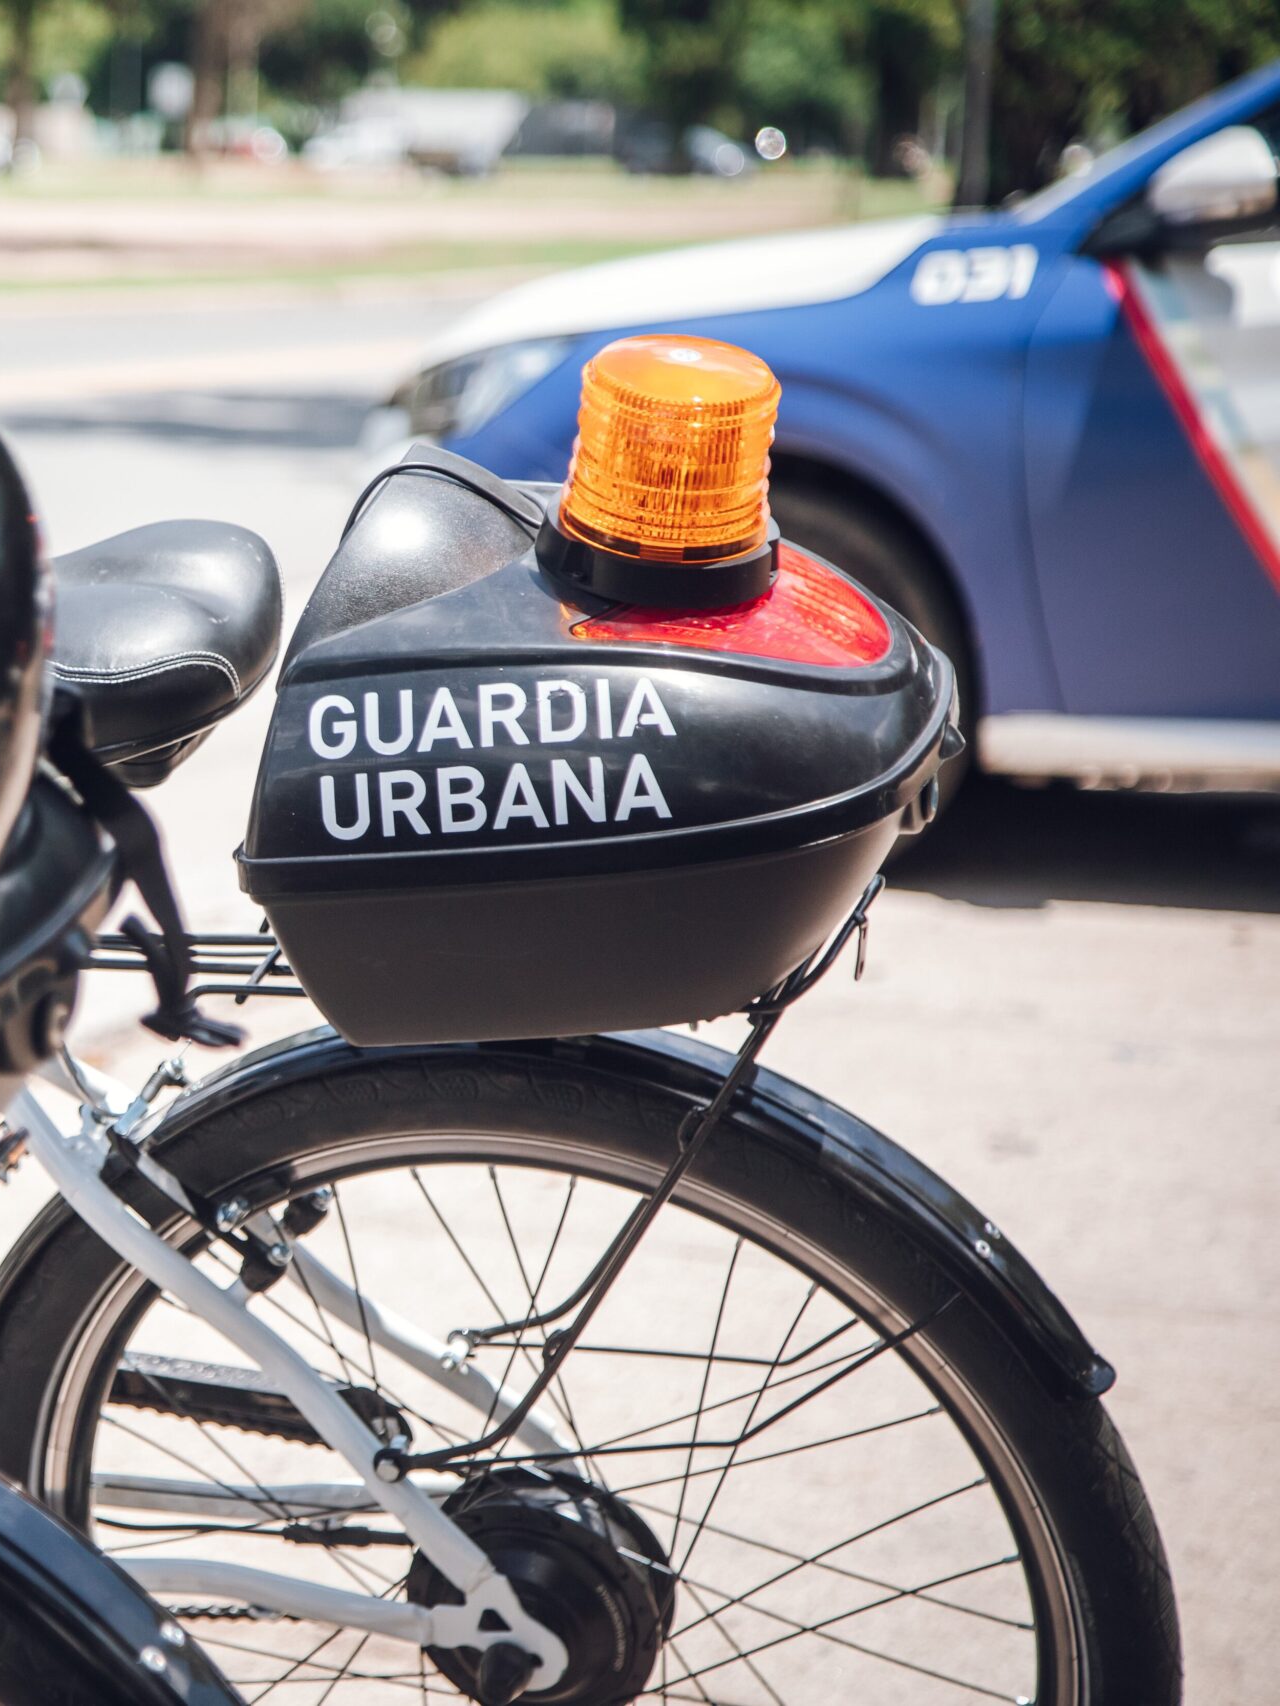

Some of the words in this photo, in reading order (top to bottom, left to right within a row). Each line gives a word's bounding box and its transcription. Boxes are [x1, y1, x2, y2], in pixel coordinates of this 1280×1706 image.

[910, 243, 1039, 306] 031
[308, 677, 677, 760] GUARDIA
[319, 753, 673, 841] URBANA
